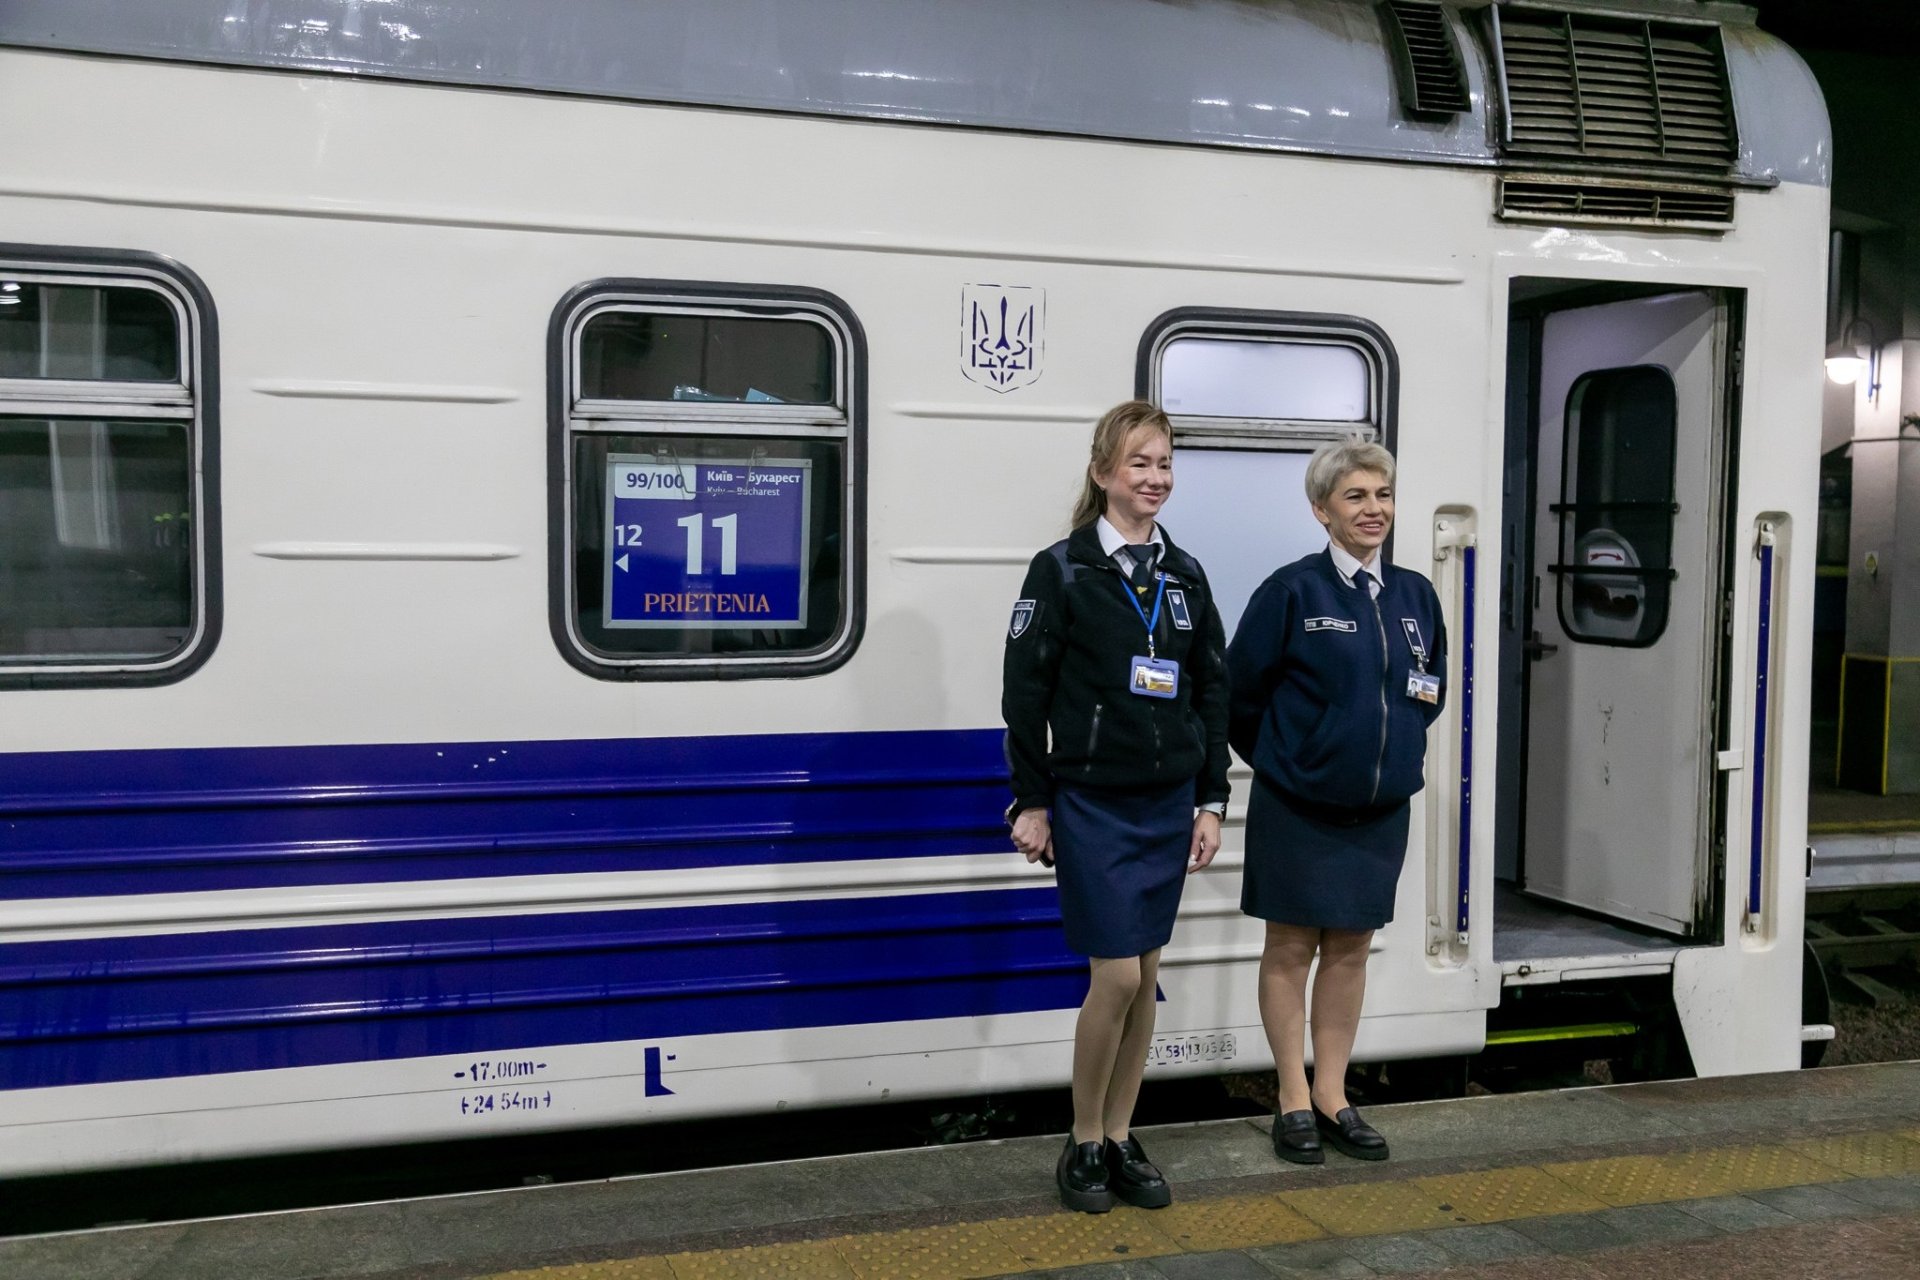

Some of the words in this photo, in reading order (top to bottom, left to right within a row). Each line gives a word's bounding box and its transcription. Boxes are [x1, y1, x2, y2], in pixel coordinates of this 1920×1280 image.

[626, 472, 685, 490] 99/100
[707, 470, 734, 482] Київ
[748, 472, 801, 486] Бухарест
[615, 524, 643, 546] 12
[677, 512, 738, 576] 11
[643, 593, 771, 613] PRIETENIA
